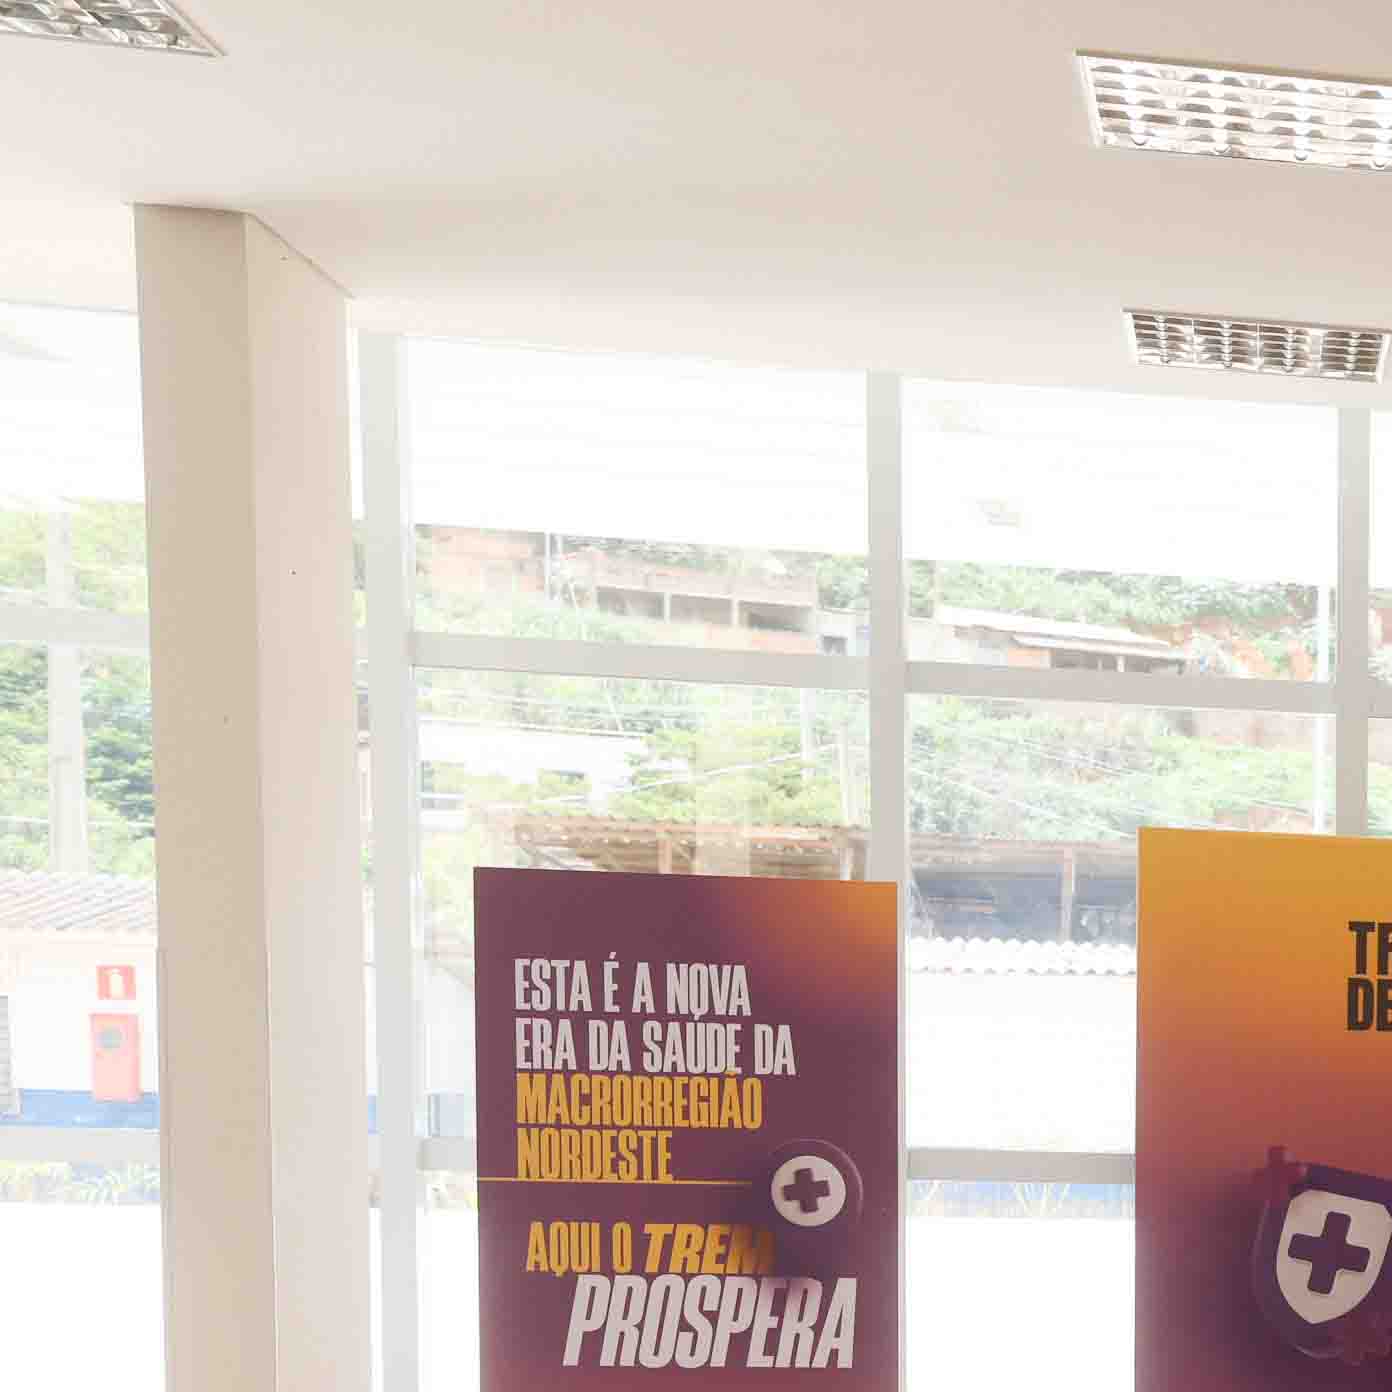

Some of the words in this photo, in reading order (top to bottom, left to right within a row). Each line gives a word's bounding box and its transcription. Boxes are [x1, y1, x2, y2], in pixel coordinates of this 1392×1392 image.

[515, 958, 592, 1012] ESTA
[603, 952, 620, 1013] É
[632, 962, 656, 1014] A
[666, 962, 752, 1017] NOVA
[515, 1017, 577, 1071] ERA
[588, 1019, 631, 1072] DA
[642, 1013, 742, 1074] SAÚDE
[753, 1024, 796, 1076] DA
[516, 1072, 763, 1129] MACRORREGIÃO
[516, 1129, 673, 1181] NORDESTE
[526, 1221, 601, 1277] AQUI
[612, 1222, 632, 1273] O
[562, 1274, 858, 1369] PROSPERA
